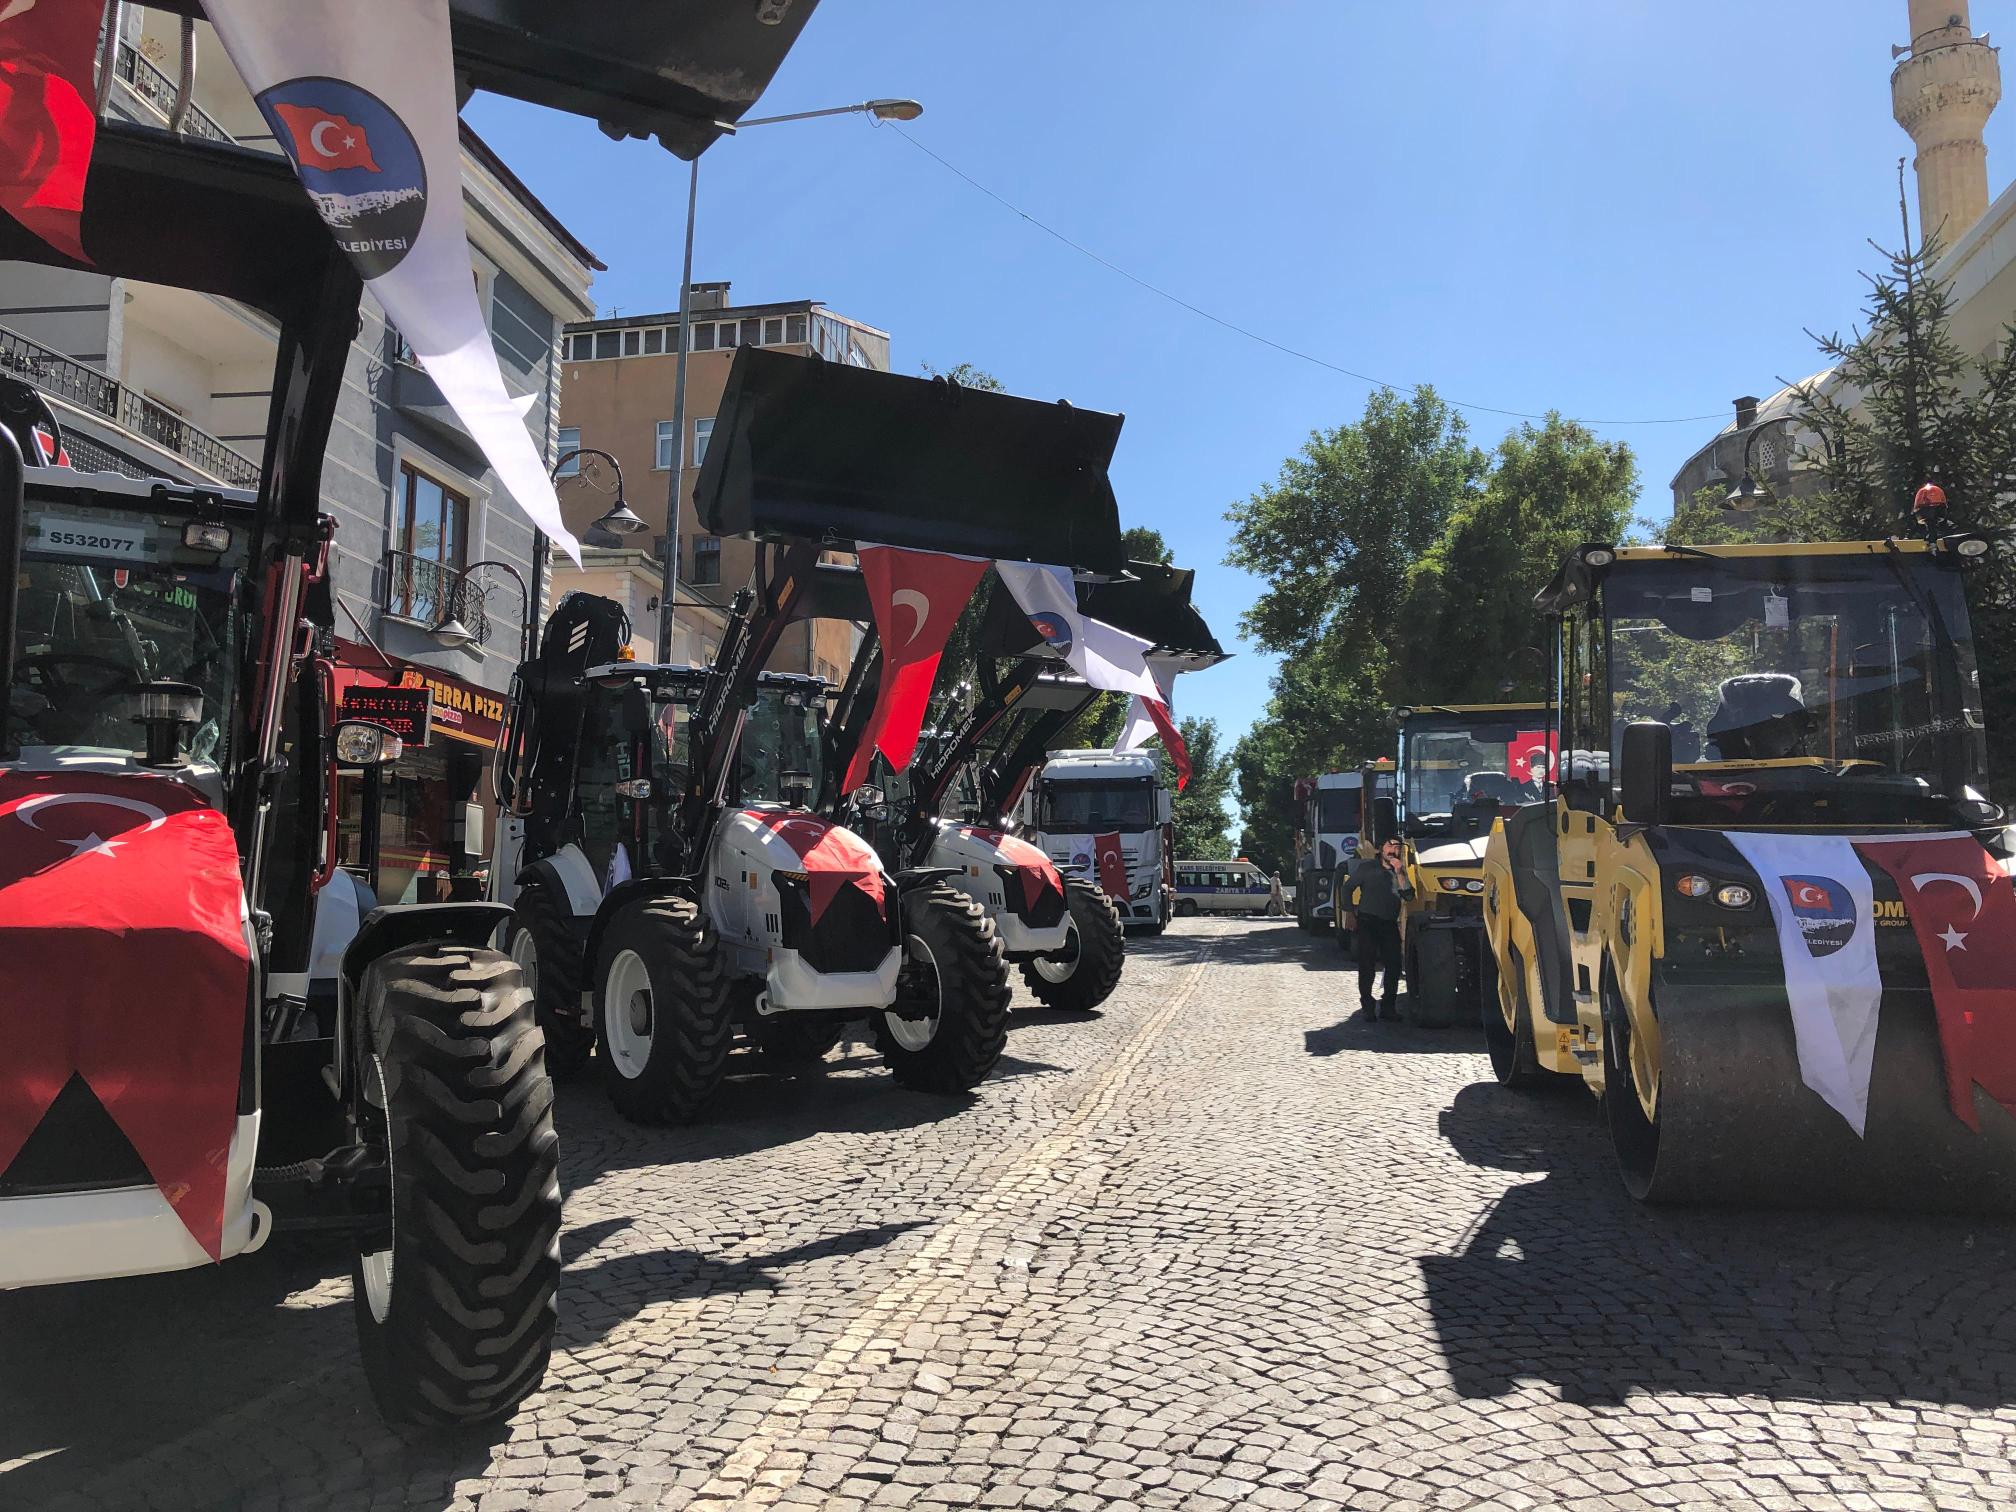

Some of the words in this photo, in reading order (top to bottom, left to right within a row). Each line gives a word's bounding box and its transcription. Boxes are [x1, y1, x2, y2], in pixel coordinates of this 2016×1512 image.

[49, 530, 135, 552] S532077
[425, 677, 473, 713] TERRA
[1879, 919, 1908, 927] GROUP
